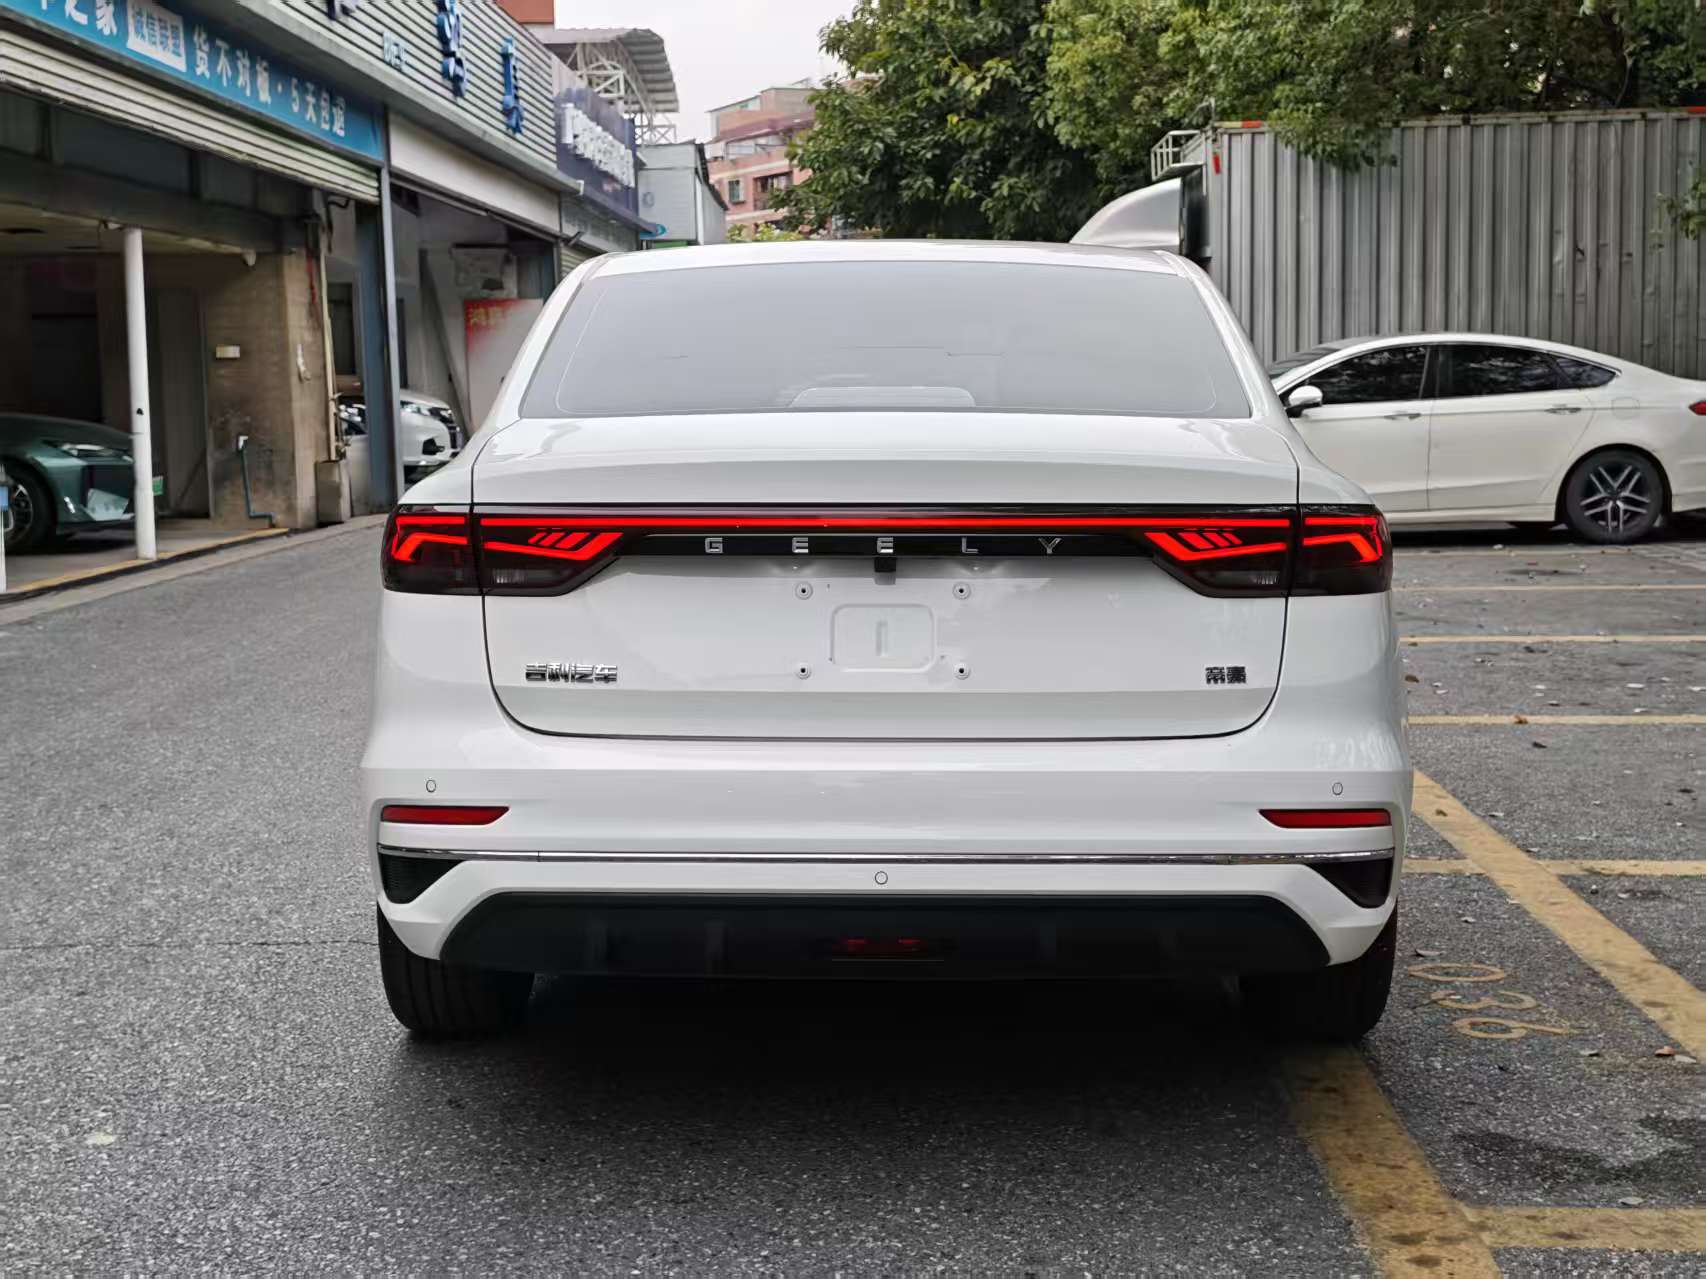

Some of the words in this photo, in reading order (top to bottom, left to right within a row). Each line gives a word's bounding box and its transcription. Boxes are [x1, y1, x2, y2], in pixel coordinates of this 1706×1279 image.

[704, 536, 1062, 554] GEELY
[525, 663, 618, 683] 吉利汽车
